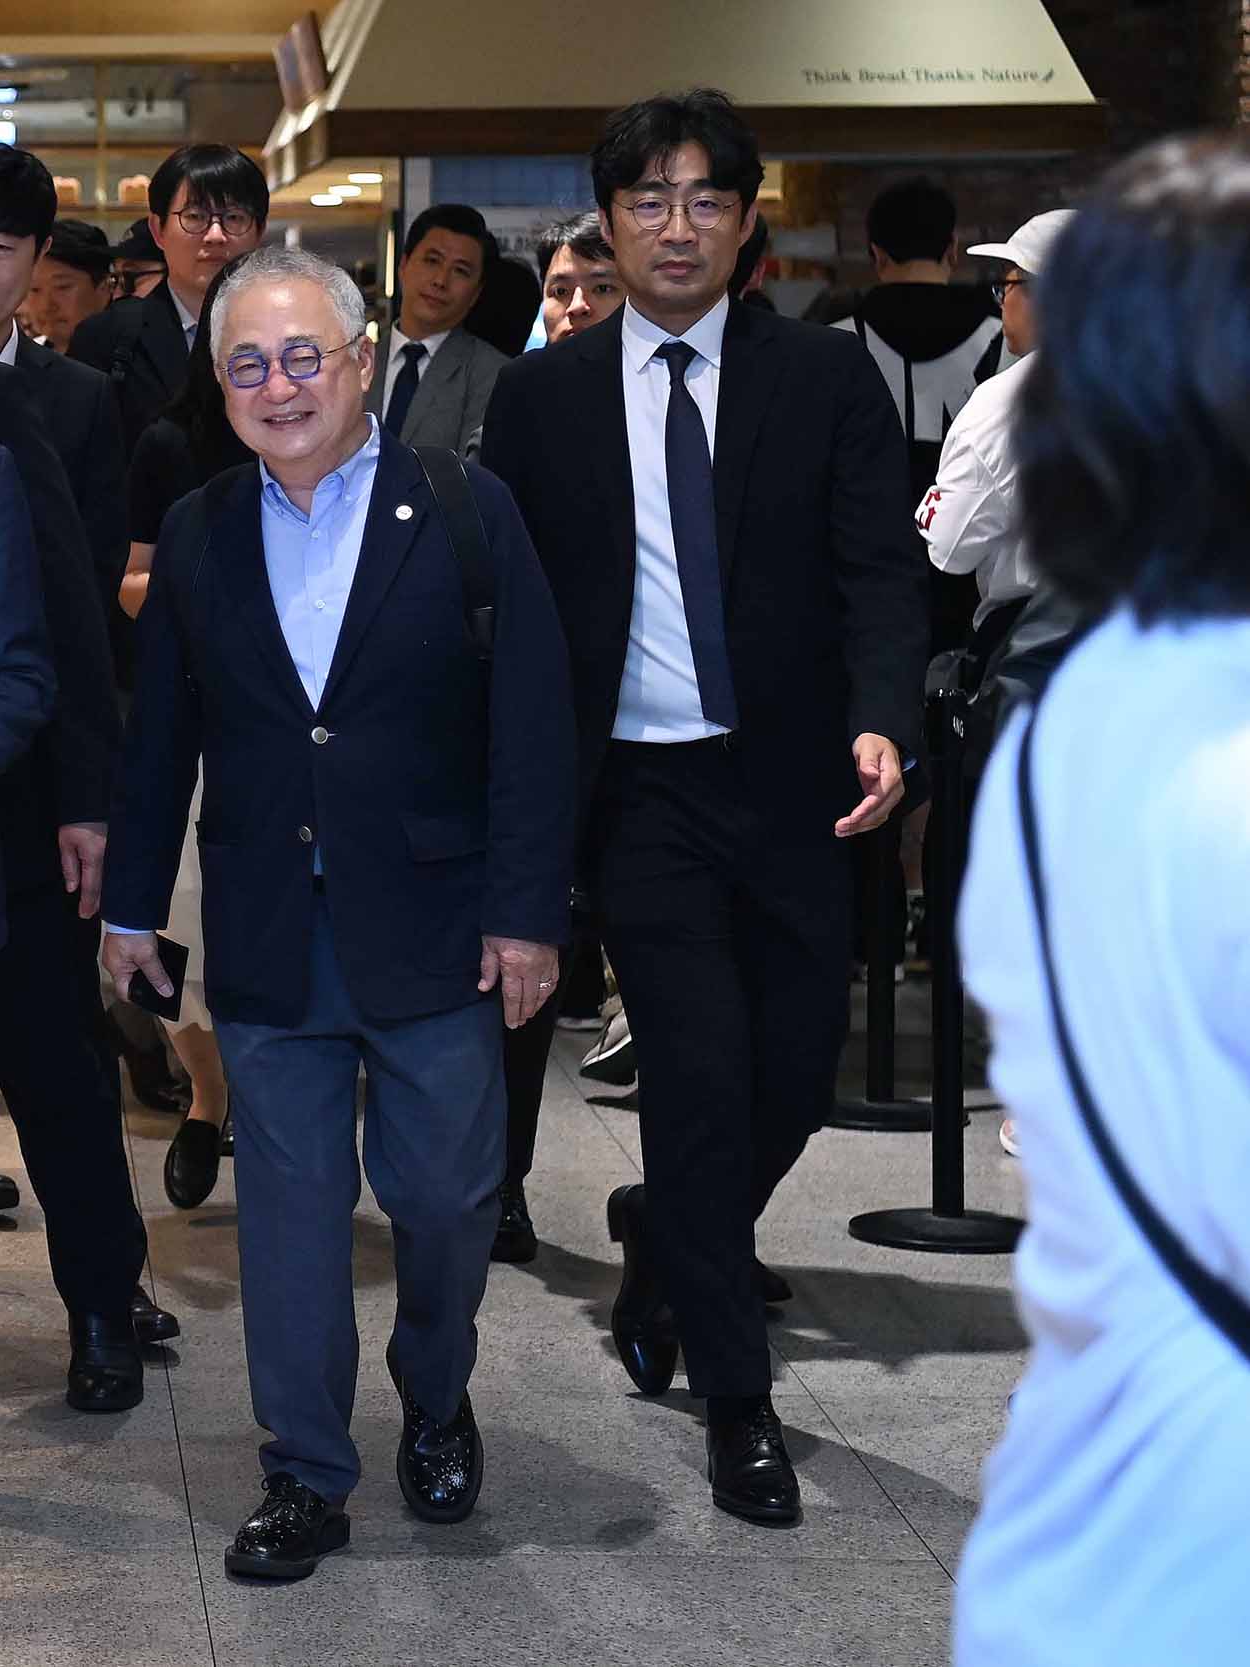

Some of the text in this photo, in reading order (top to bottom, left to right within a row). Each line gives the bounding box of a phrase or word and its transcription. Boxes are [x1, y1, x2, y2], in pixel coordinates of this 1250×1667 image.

[802, 66, 1039, 83] Think Bread Thanks Nature
